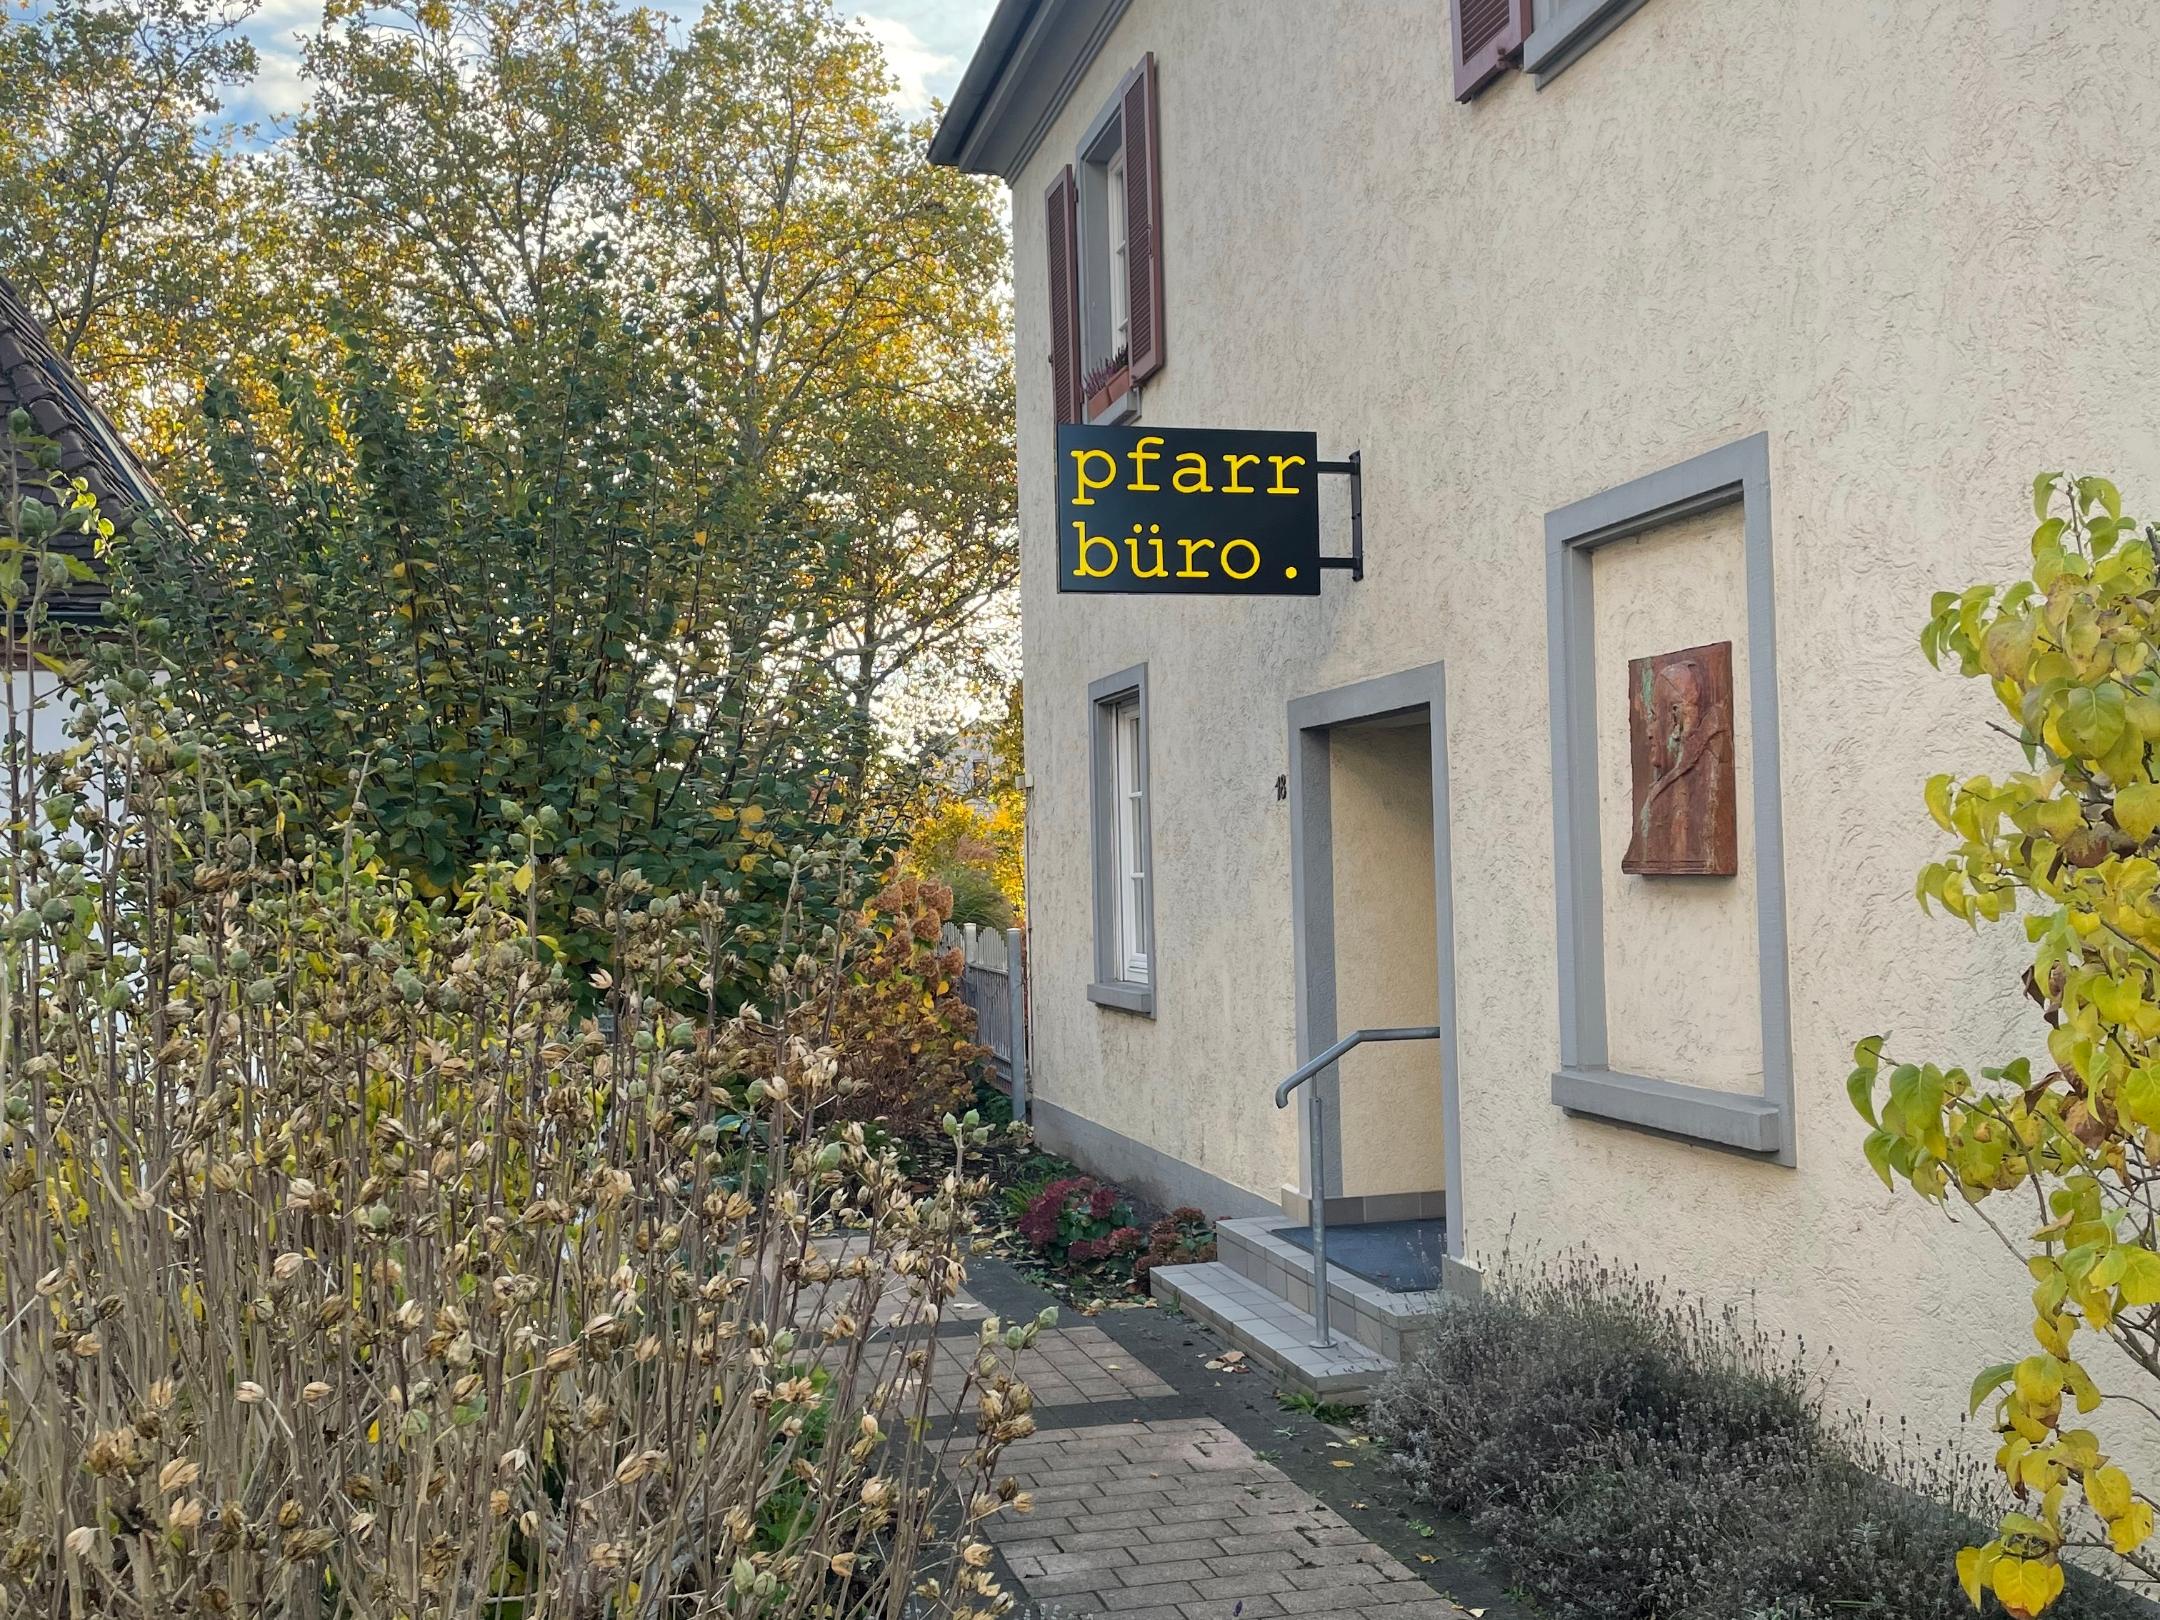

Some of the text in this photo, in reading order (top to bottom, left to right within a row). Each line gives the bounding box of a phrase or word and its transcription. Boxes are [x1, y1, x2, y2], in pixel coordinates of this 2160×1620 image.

[1070, 436, 1306, 505] pfarr
[1071, 521, 1298, 580] büro.
[1274, 773, 1287, 801] 18
